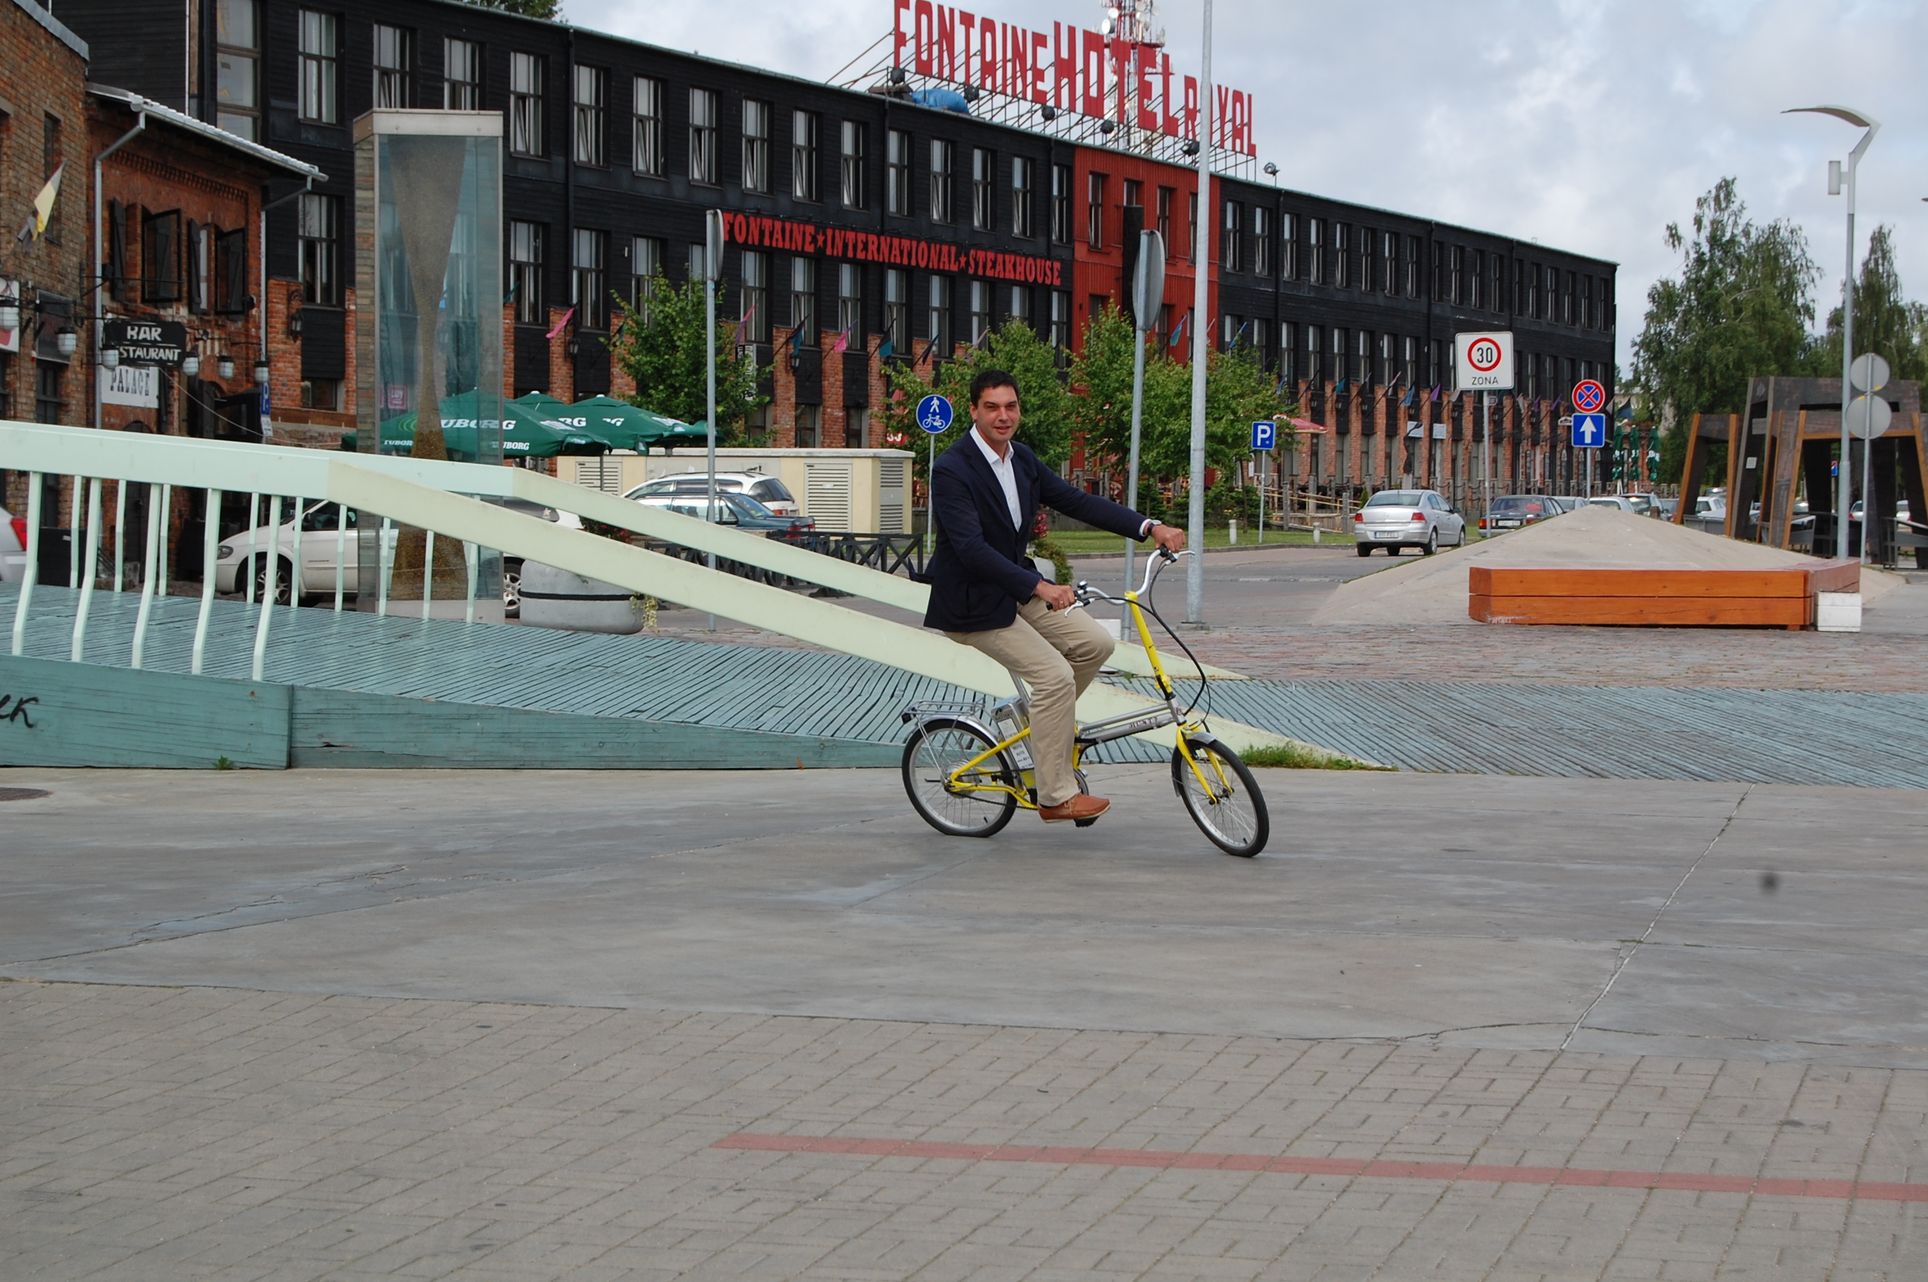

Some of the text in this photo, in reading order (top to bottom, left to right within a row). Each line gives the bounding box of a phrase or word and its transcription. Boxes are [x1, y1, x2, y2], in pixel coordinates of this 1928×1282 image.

[893, 0, 1257, 158] FONTAINE HOTEL RYAL
[723, 211, 1062, 287] FONTAINE INTERNATIONAL STEAKHOUSE
[116, 345, 182, 361] STAURANT
[1476, 347, 1493, 364] 30
[1471, 376, 1499, 386] ZONA
[1257, 424, 1272, 446] P
